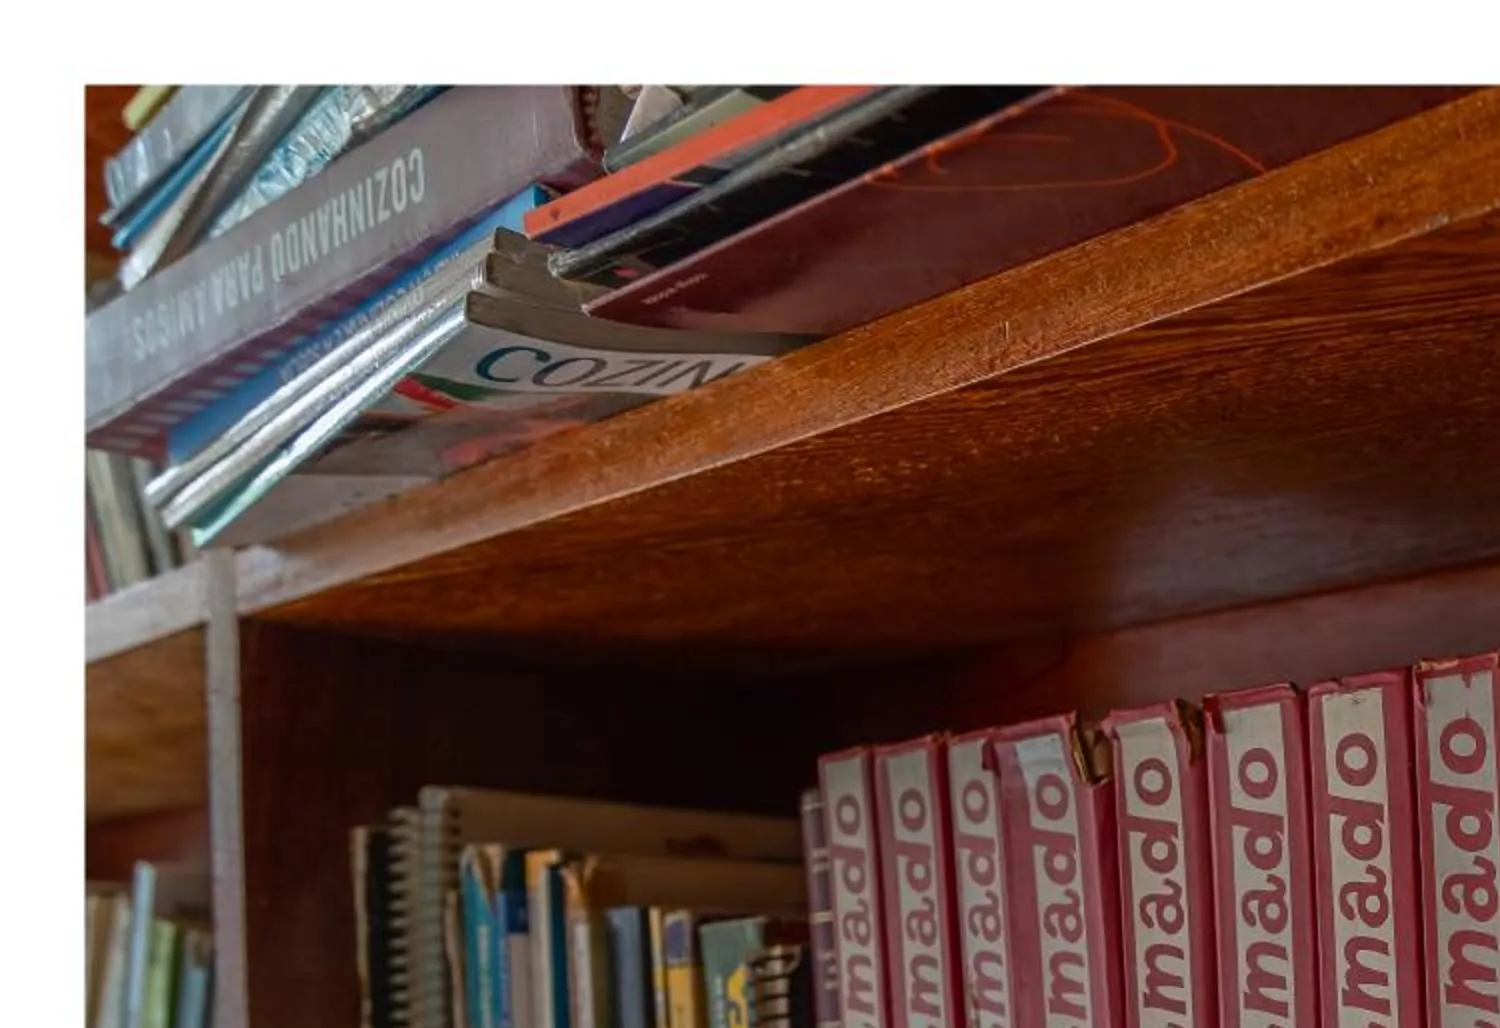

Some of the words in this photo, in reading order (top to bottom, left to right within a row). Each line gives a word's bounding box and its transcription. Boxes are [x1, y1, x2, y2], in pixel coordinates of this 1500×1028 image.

[270, 147, 425, 283] COZINHANDO
[133, 280, 206, 360] AMIGOS
[214, 260, 264, 314] PARA
